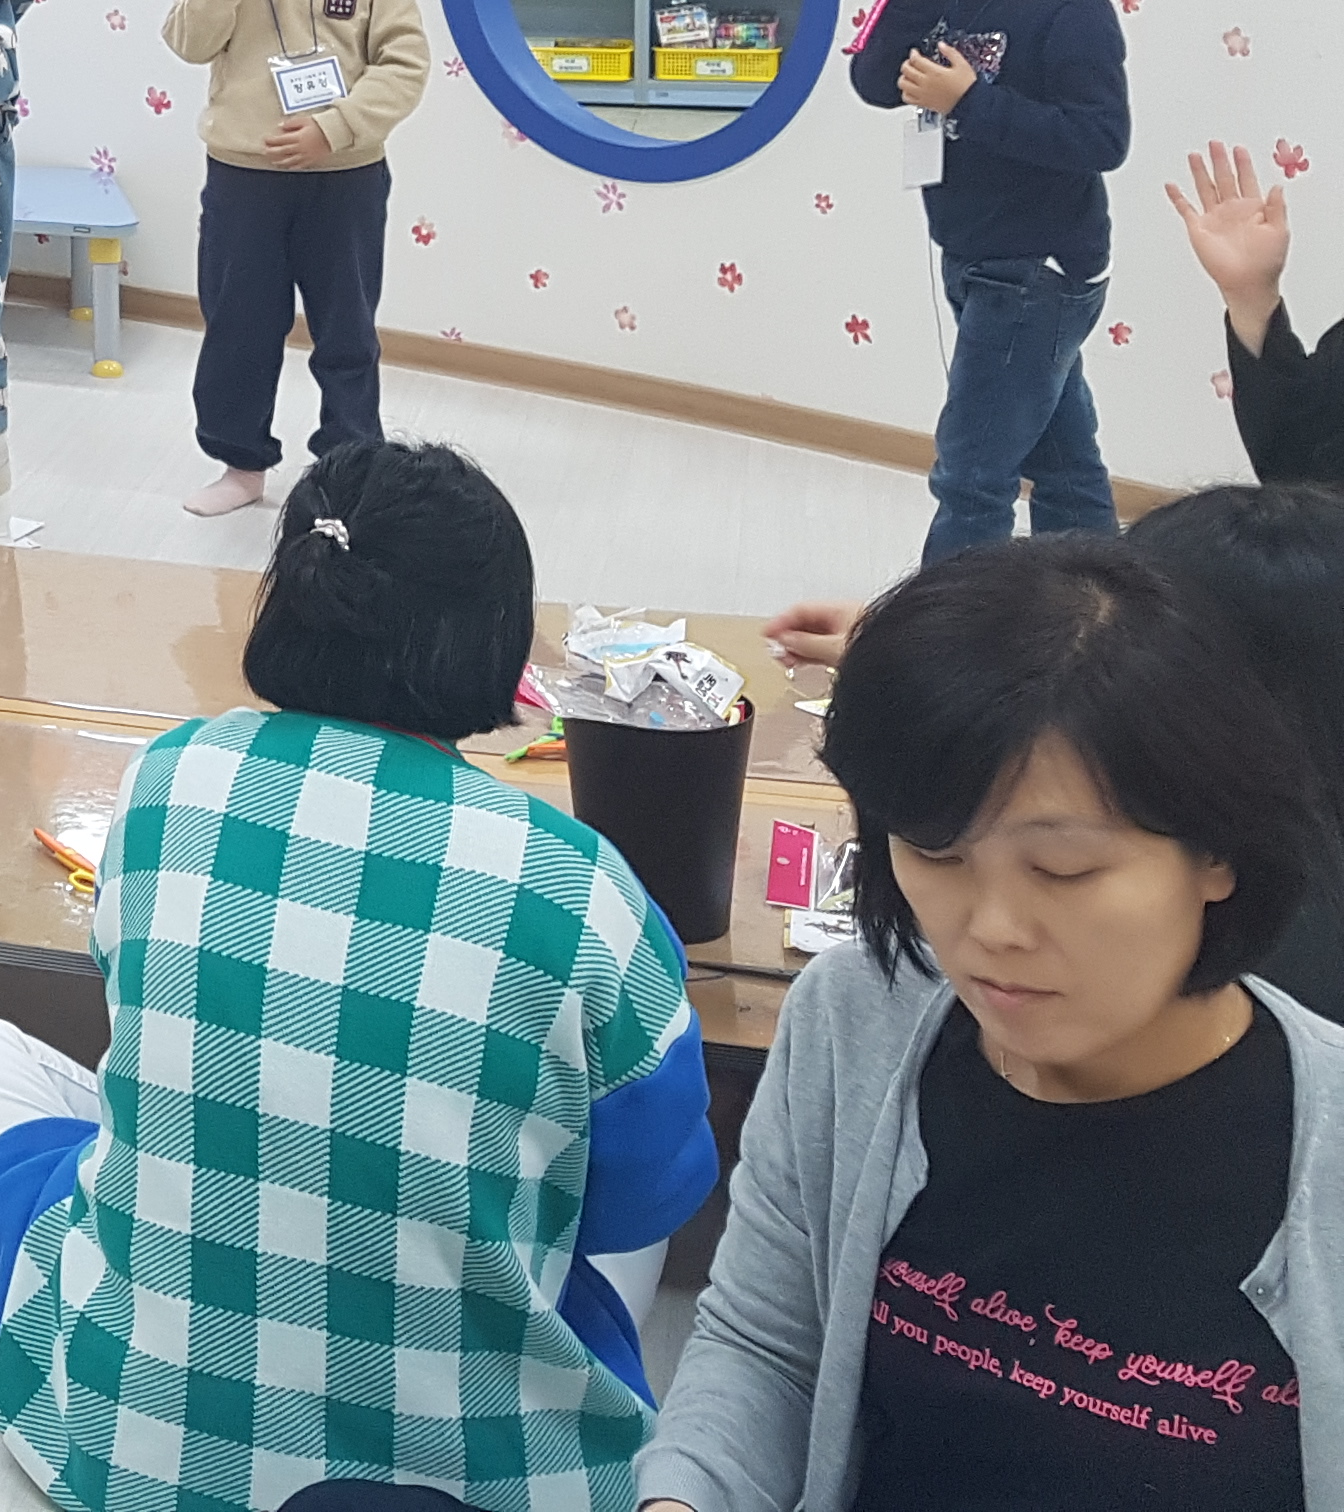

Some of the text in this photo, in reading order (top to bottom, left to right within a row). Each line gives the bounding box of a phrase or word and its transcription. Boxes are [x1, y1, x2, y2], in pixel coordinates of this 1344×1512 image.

[890, 1314, 928, 1345] you
[932, 1334, 1003, 1379] people,
[1008, 1358, 1057, 1399] keep
[1059, 1384, 1153, 1430] yourself
[1156, 1413, 1219, 1446] alive
